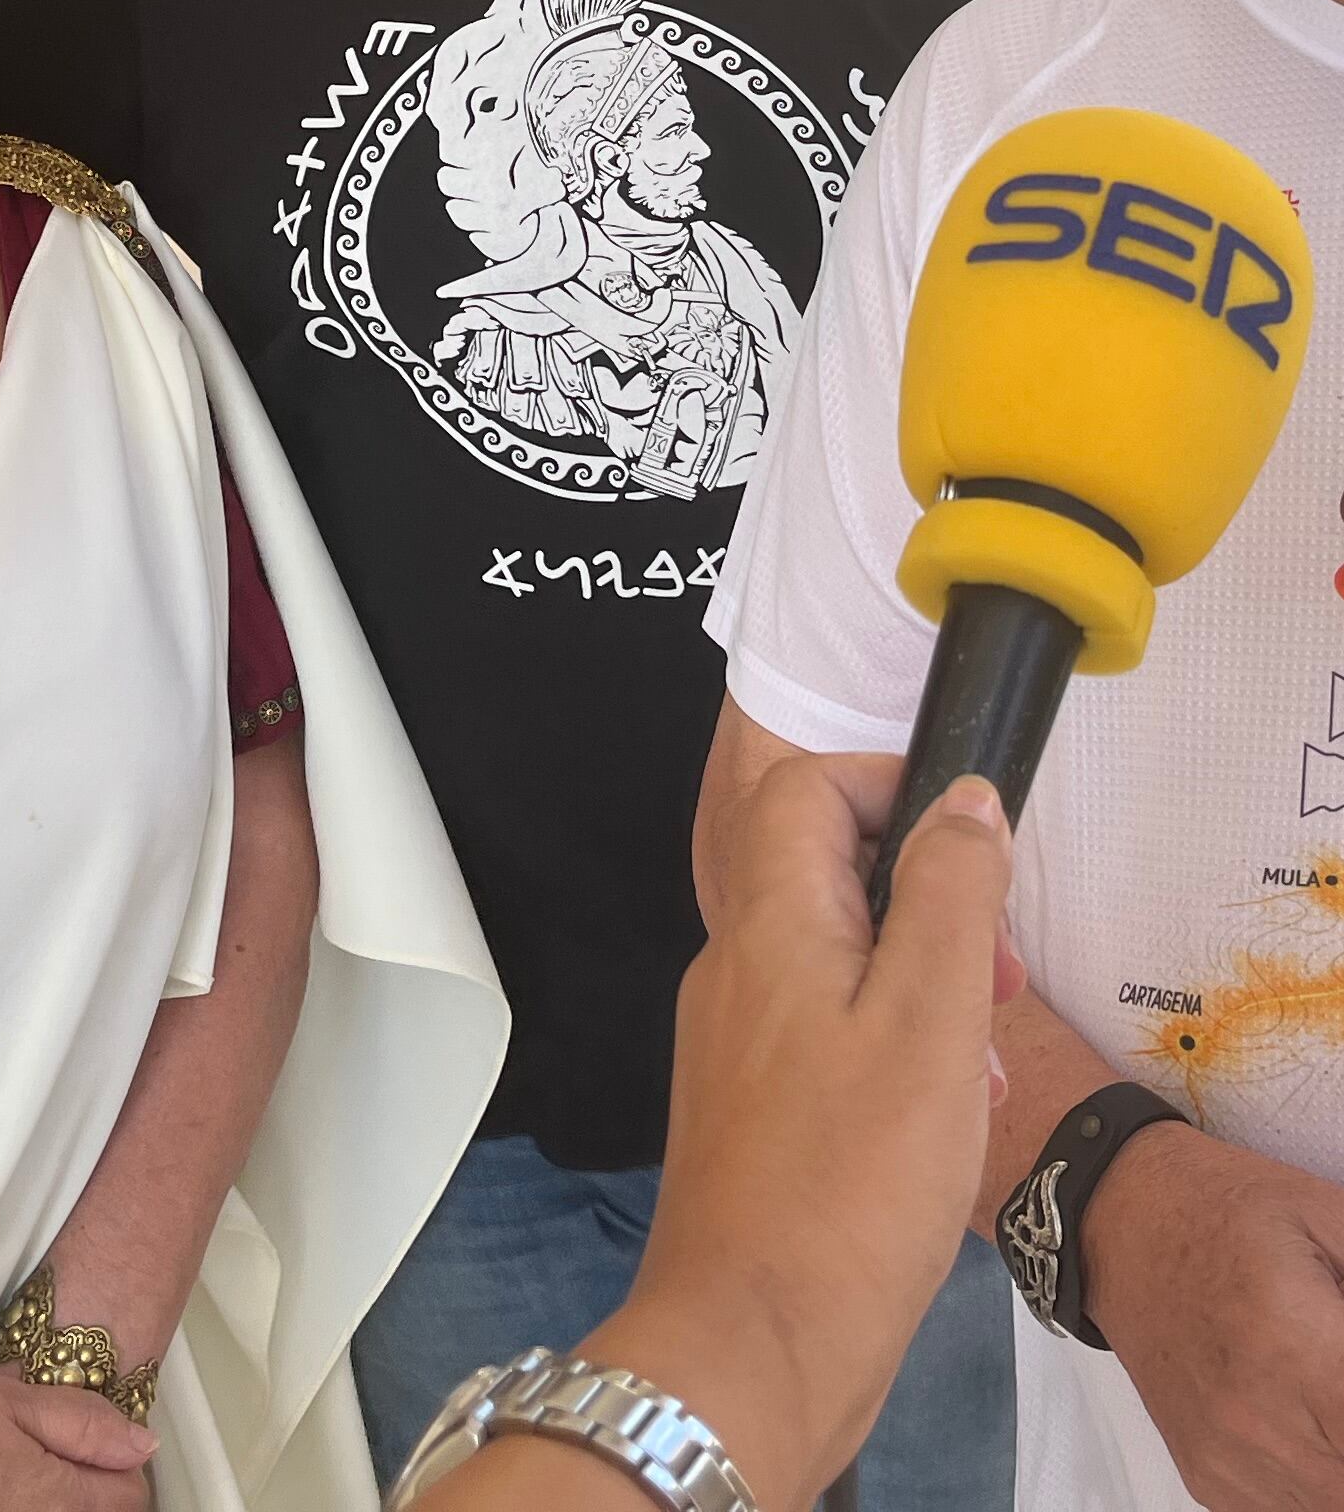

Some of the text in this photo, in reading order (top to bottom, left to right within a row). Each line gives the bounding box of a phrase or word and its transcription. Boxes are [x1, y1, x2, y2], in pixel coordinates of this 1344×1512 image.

[966, 173, 1293, 372] SER
[1261, 867, 1321, 888] MULA
[1118, 982, 1202, 1016] CARTAGENA
